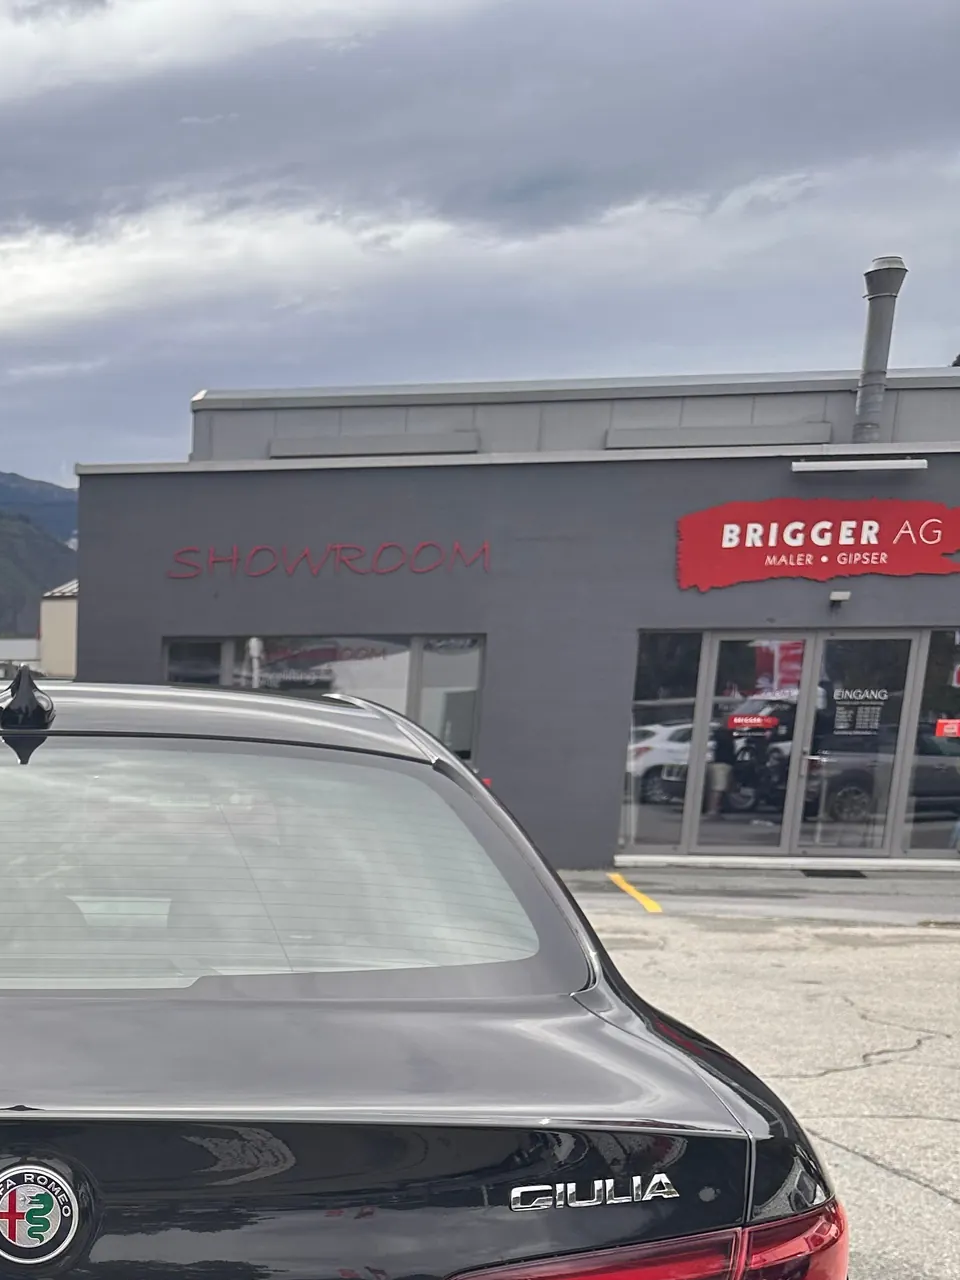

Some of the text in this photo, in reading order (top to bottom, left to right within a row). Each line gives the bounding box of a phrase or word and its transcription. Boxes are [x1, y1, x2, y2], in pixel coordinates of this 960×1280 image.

[721, 518, 944, 549] BRIGGER AG
[167, 539, 490, 579] SHOWROOM
[764, 551, 889, 566] MALER GIPSER
[833, 688, 889, 700] EINGANG
[24, 1173, 72, 1218] ROMEO
[510, 1172, 680, 1212] GIULIA
